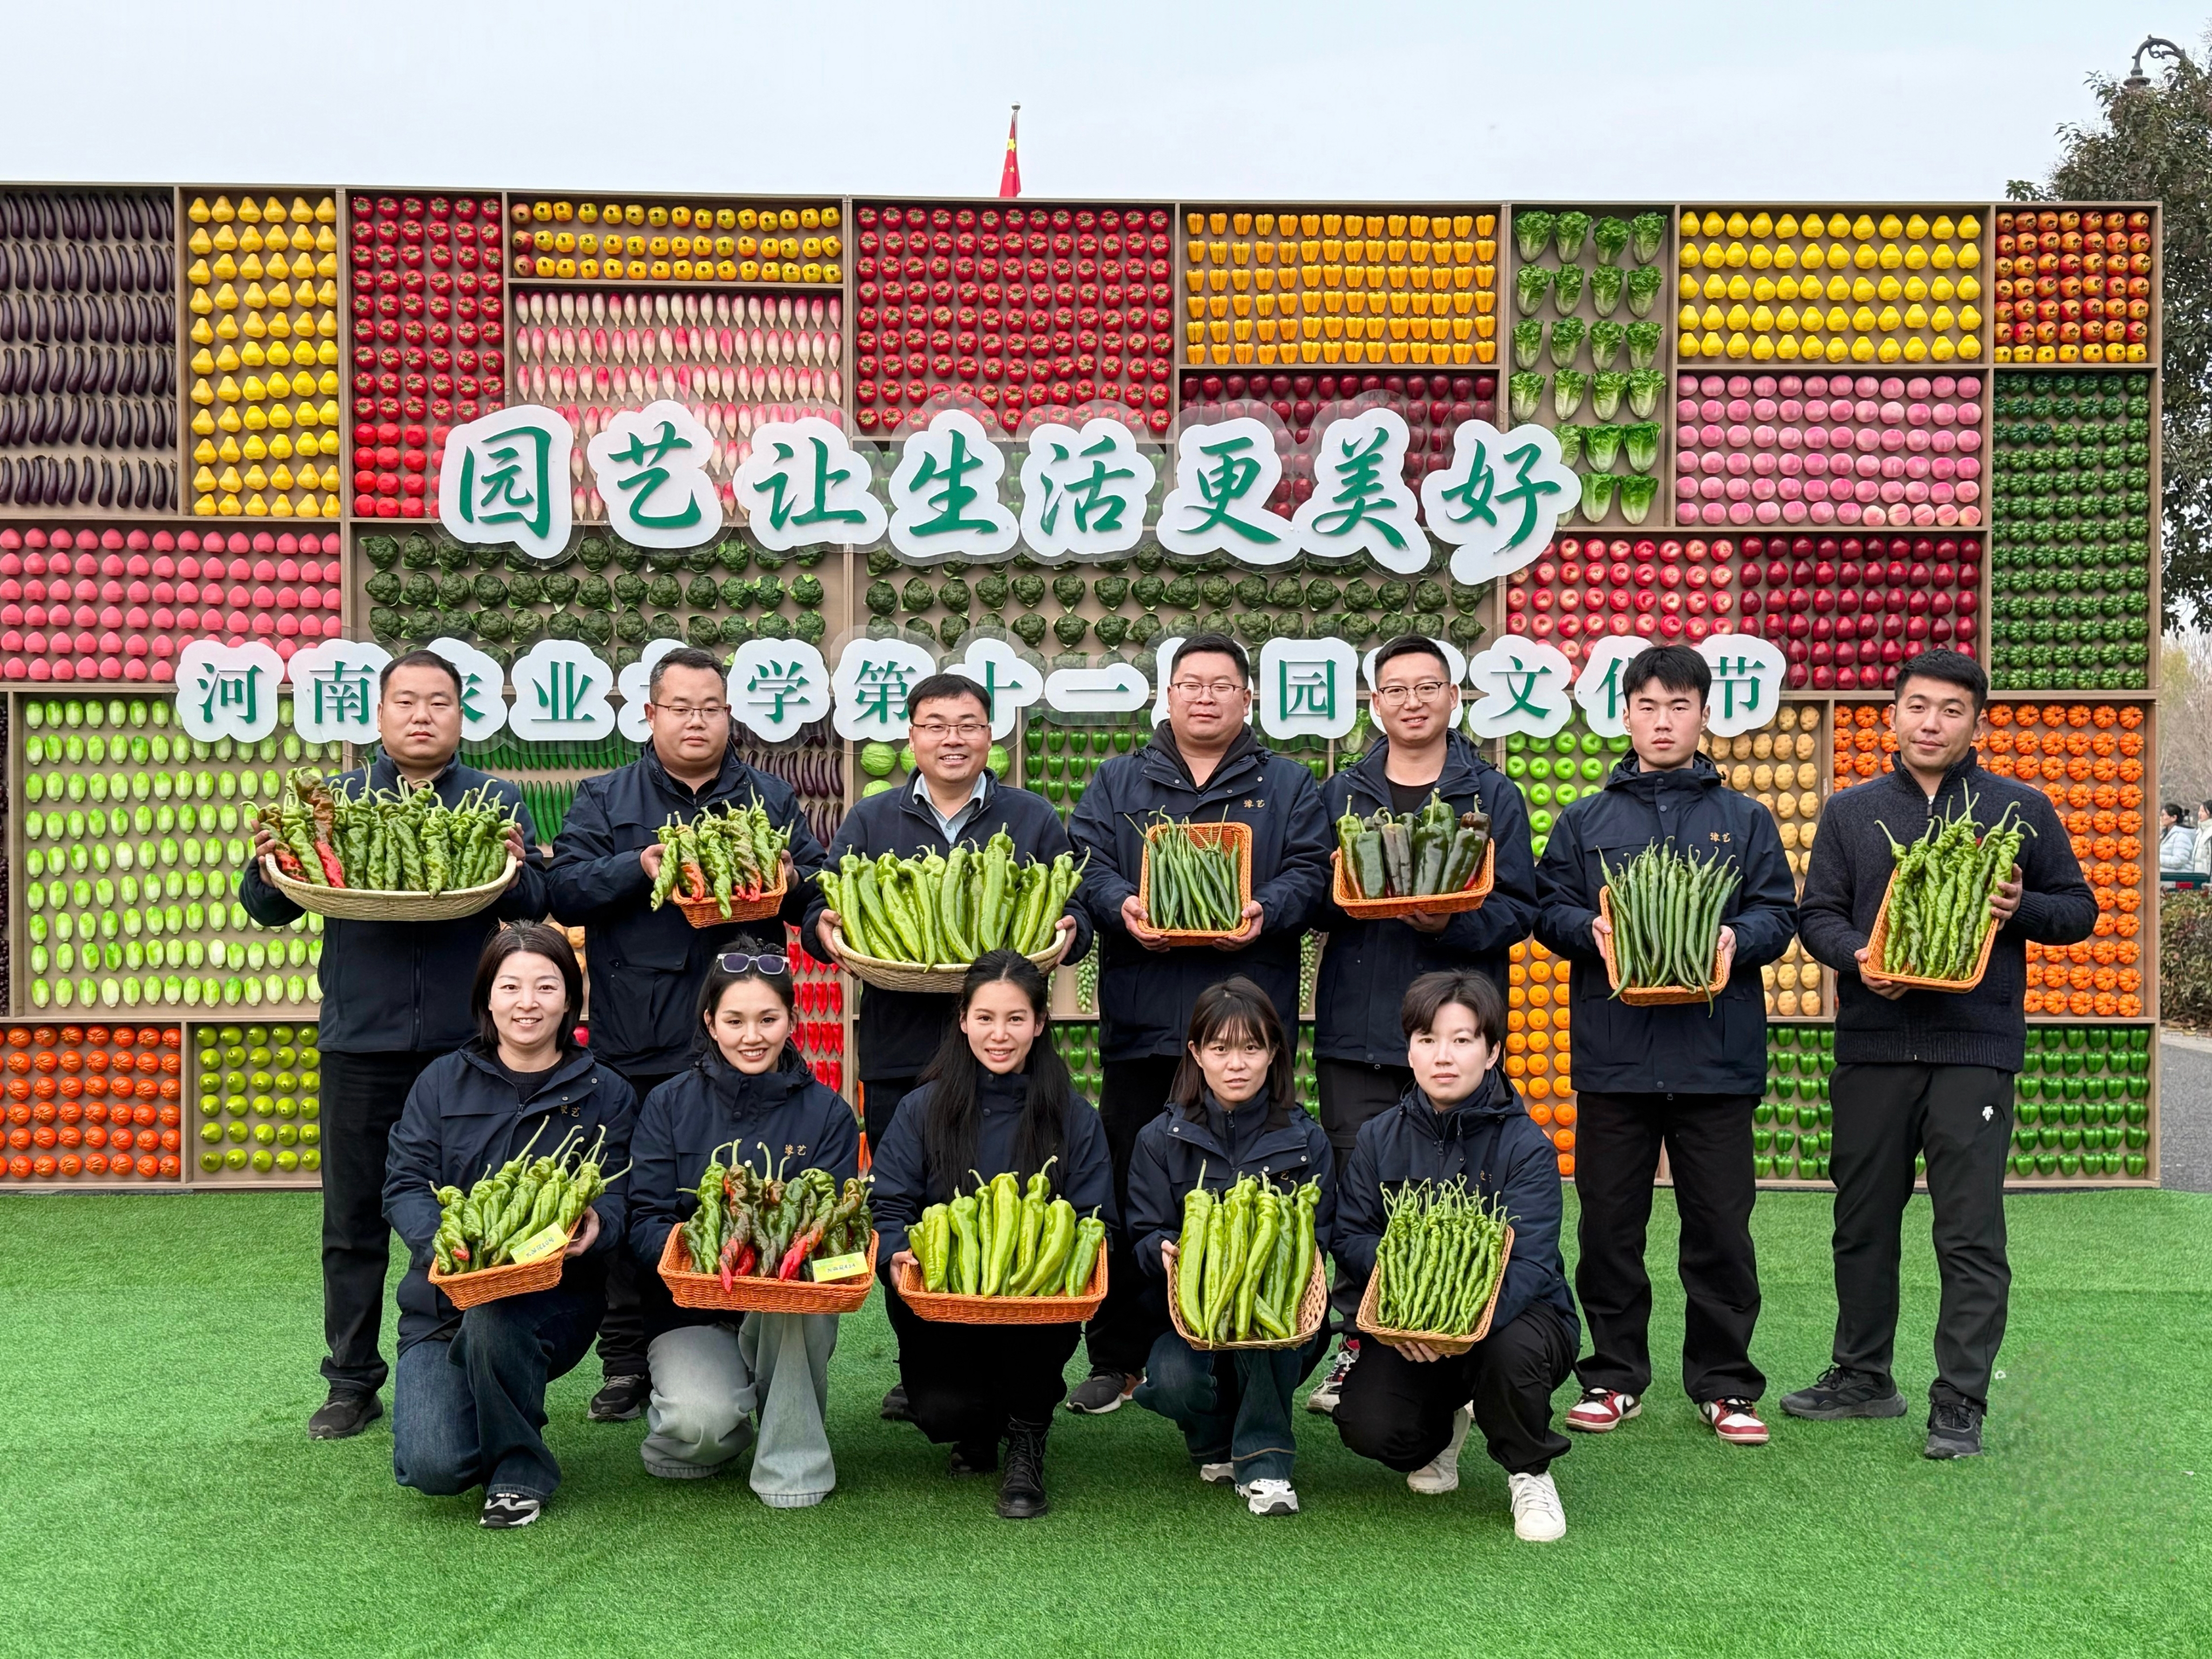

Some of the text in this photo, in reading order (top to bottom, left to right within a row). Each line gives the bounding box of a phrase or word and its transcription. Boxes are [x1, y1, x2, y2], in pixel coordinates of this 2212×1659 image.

[458, 421, 1562, 554] 园艺让生活更美好
[197, 657, 1766, 724] 河南业学第十一园文节
